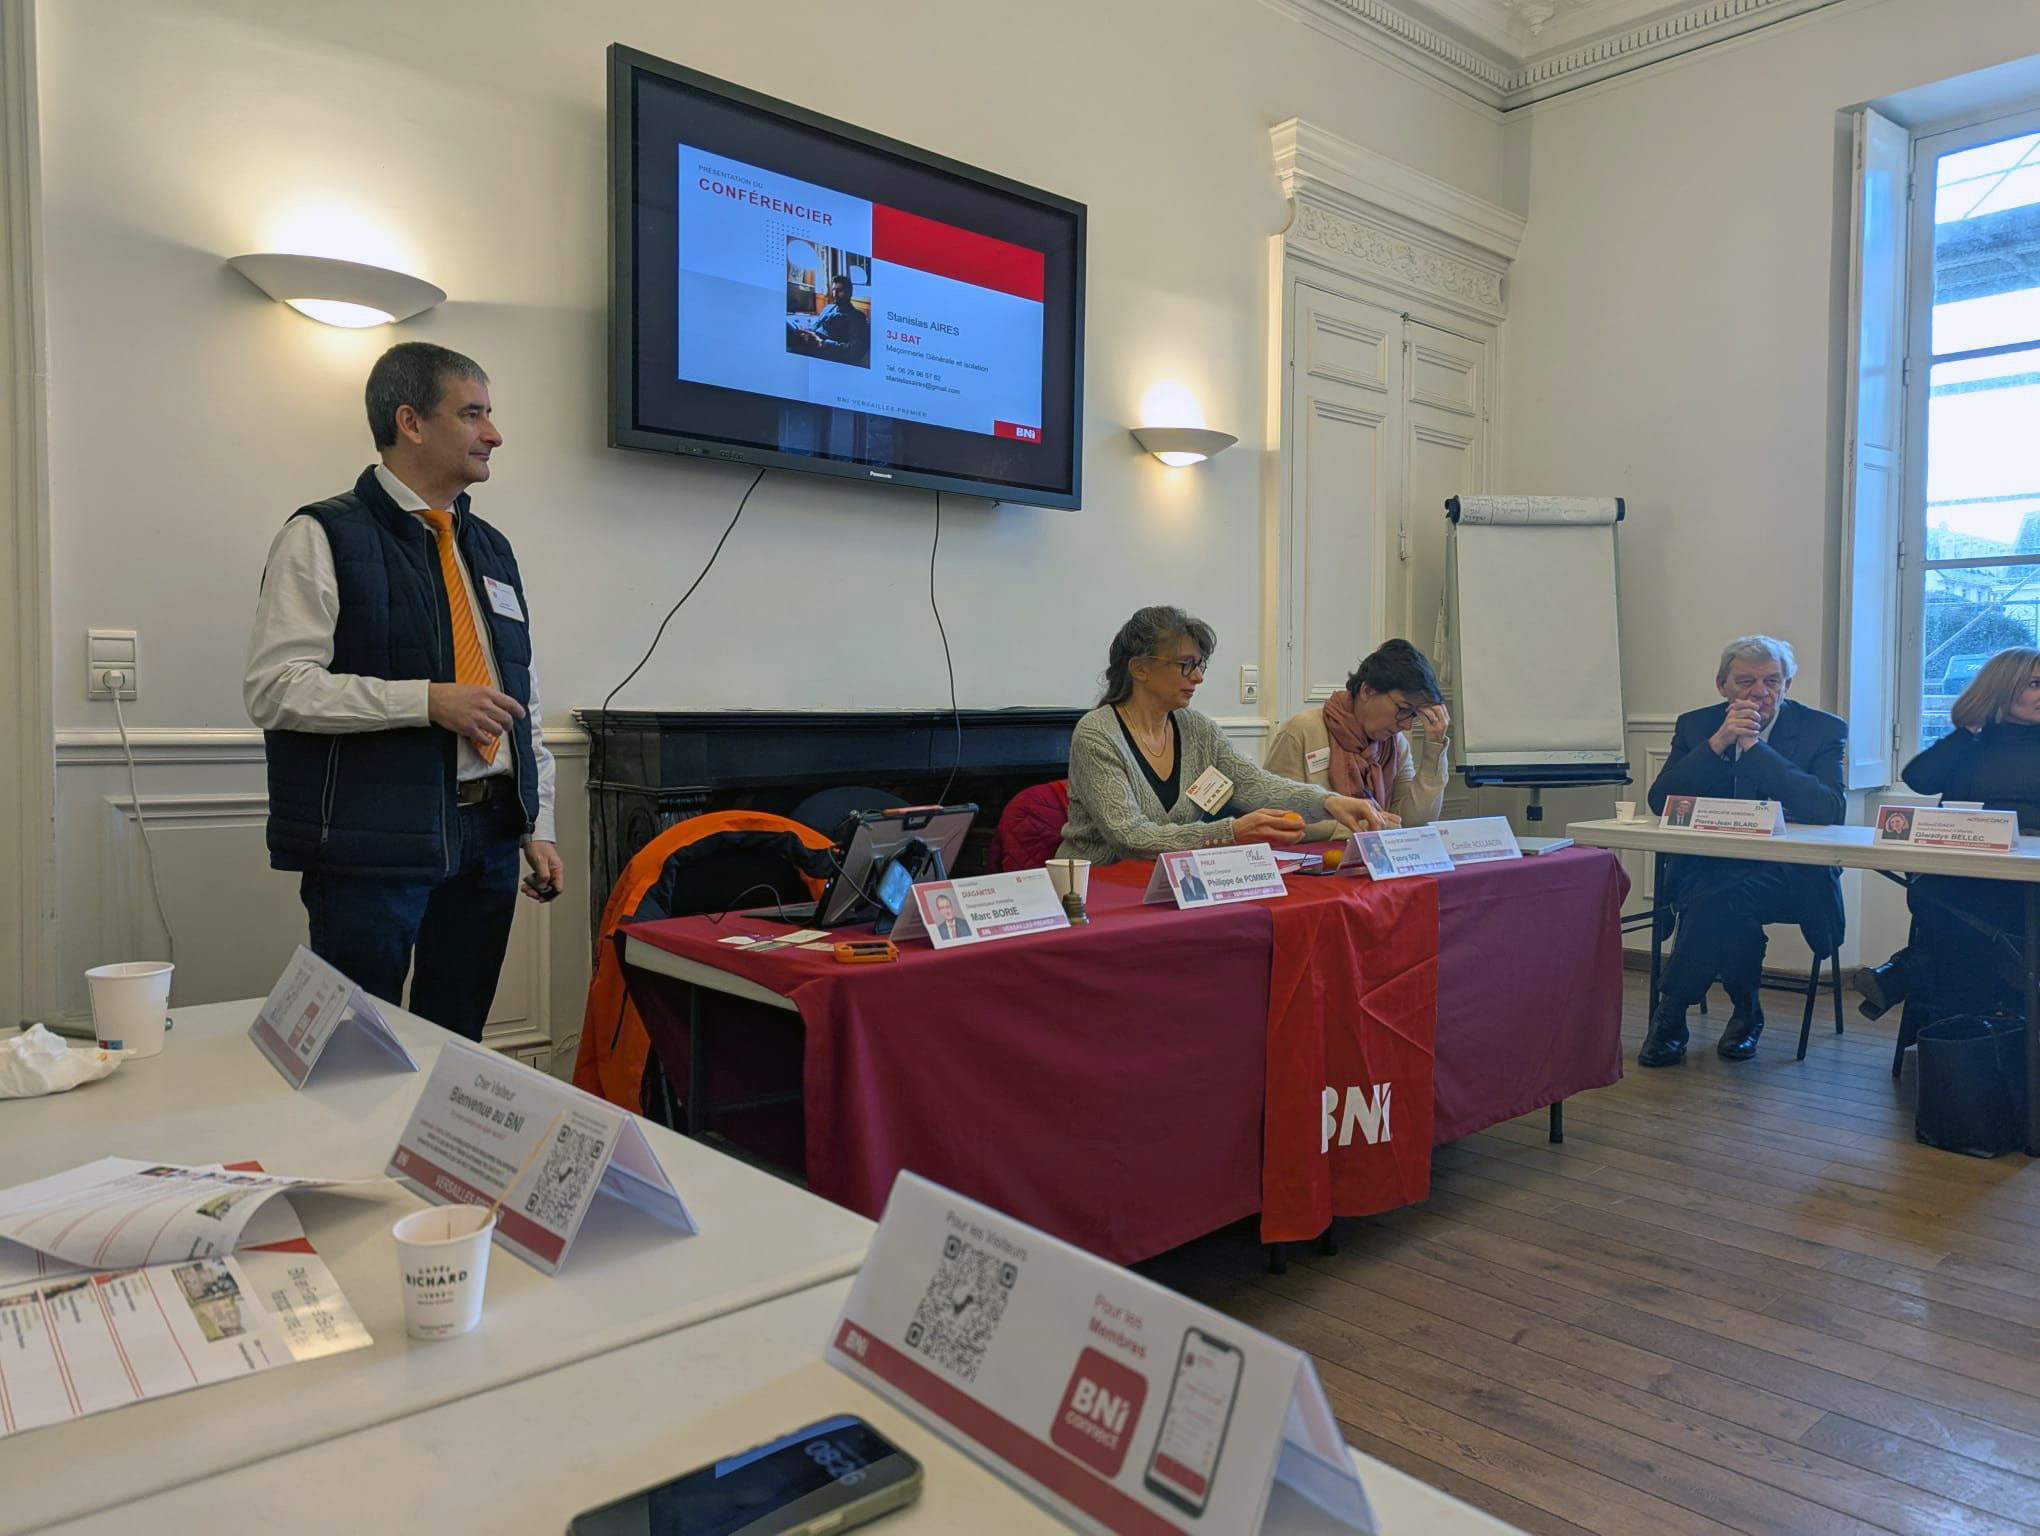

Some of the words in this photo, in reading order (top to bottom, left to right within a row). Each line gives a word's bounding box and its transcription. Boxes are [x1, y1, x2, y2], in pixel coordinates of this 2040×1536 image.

[752, 180, 764, 190] DU
[698, 178, 833, 227] CONFÉRENCIER
[886, 330, 898, 340] 3J
[900, 333, 921, 345] BAT
[887, 311, 928, 329] Stanislas
[930, 322, 960, 336] AIRES
[1951, 834, 1985, 842] BELLEC
[970, 912, 992, 921] Marc
[992, 906, 1020, 918] BORIE
[474, 1074, 491, 1091] Cher
[490, 1080, 517, 1102] Visiteur
[449, 1085, 493, 1118] Bienvenue
[491, 1109, 506, 1125] au
[503, 1111, 526, 1133] BNI
[1093, 1292, 1123, 1319] Pour
[1124, 1309, 1143, 1330] les
[1088, 1316, 1147, 1359] Membres
[1064, 1409, 1120, 1450] connect
